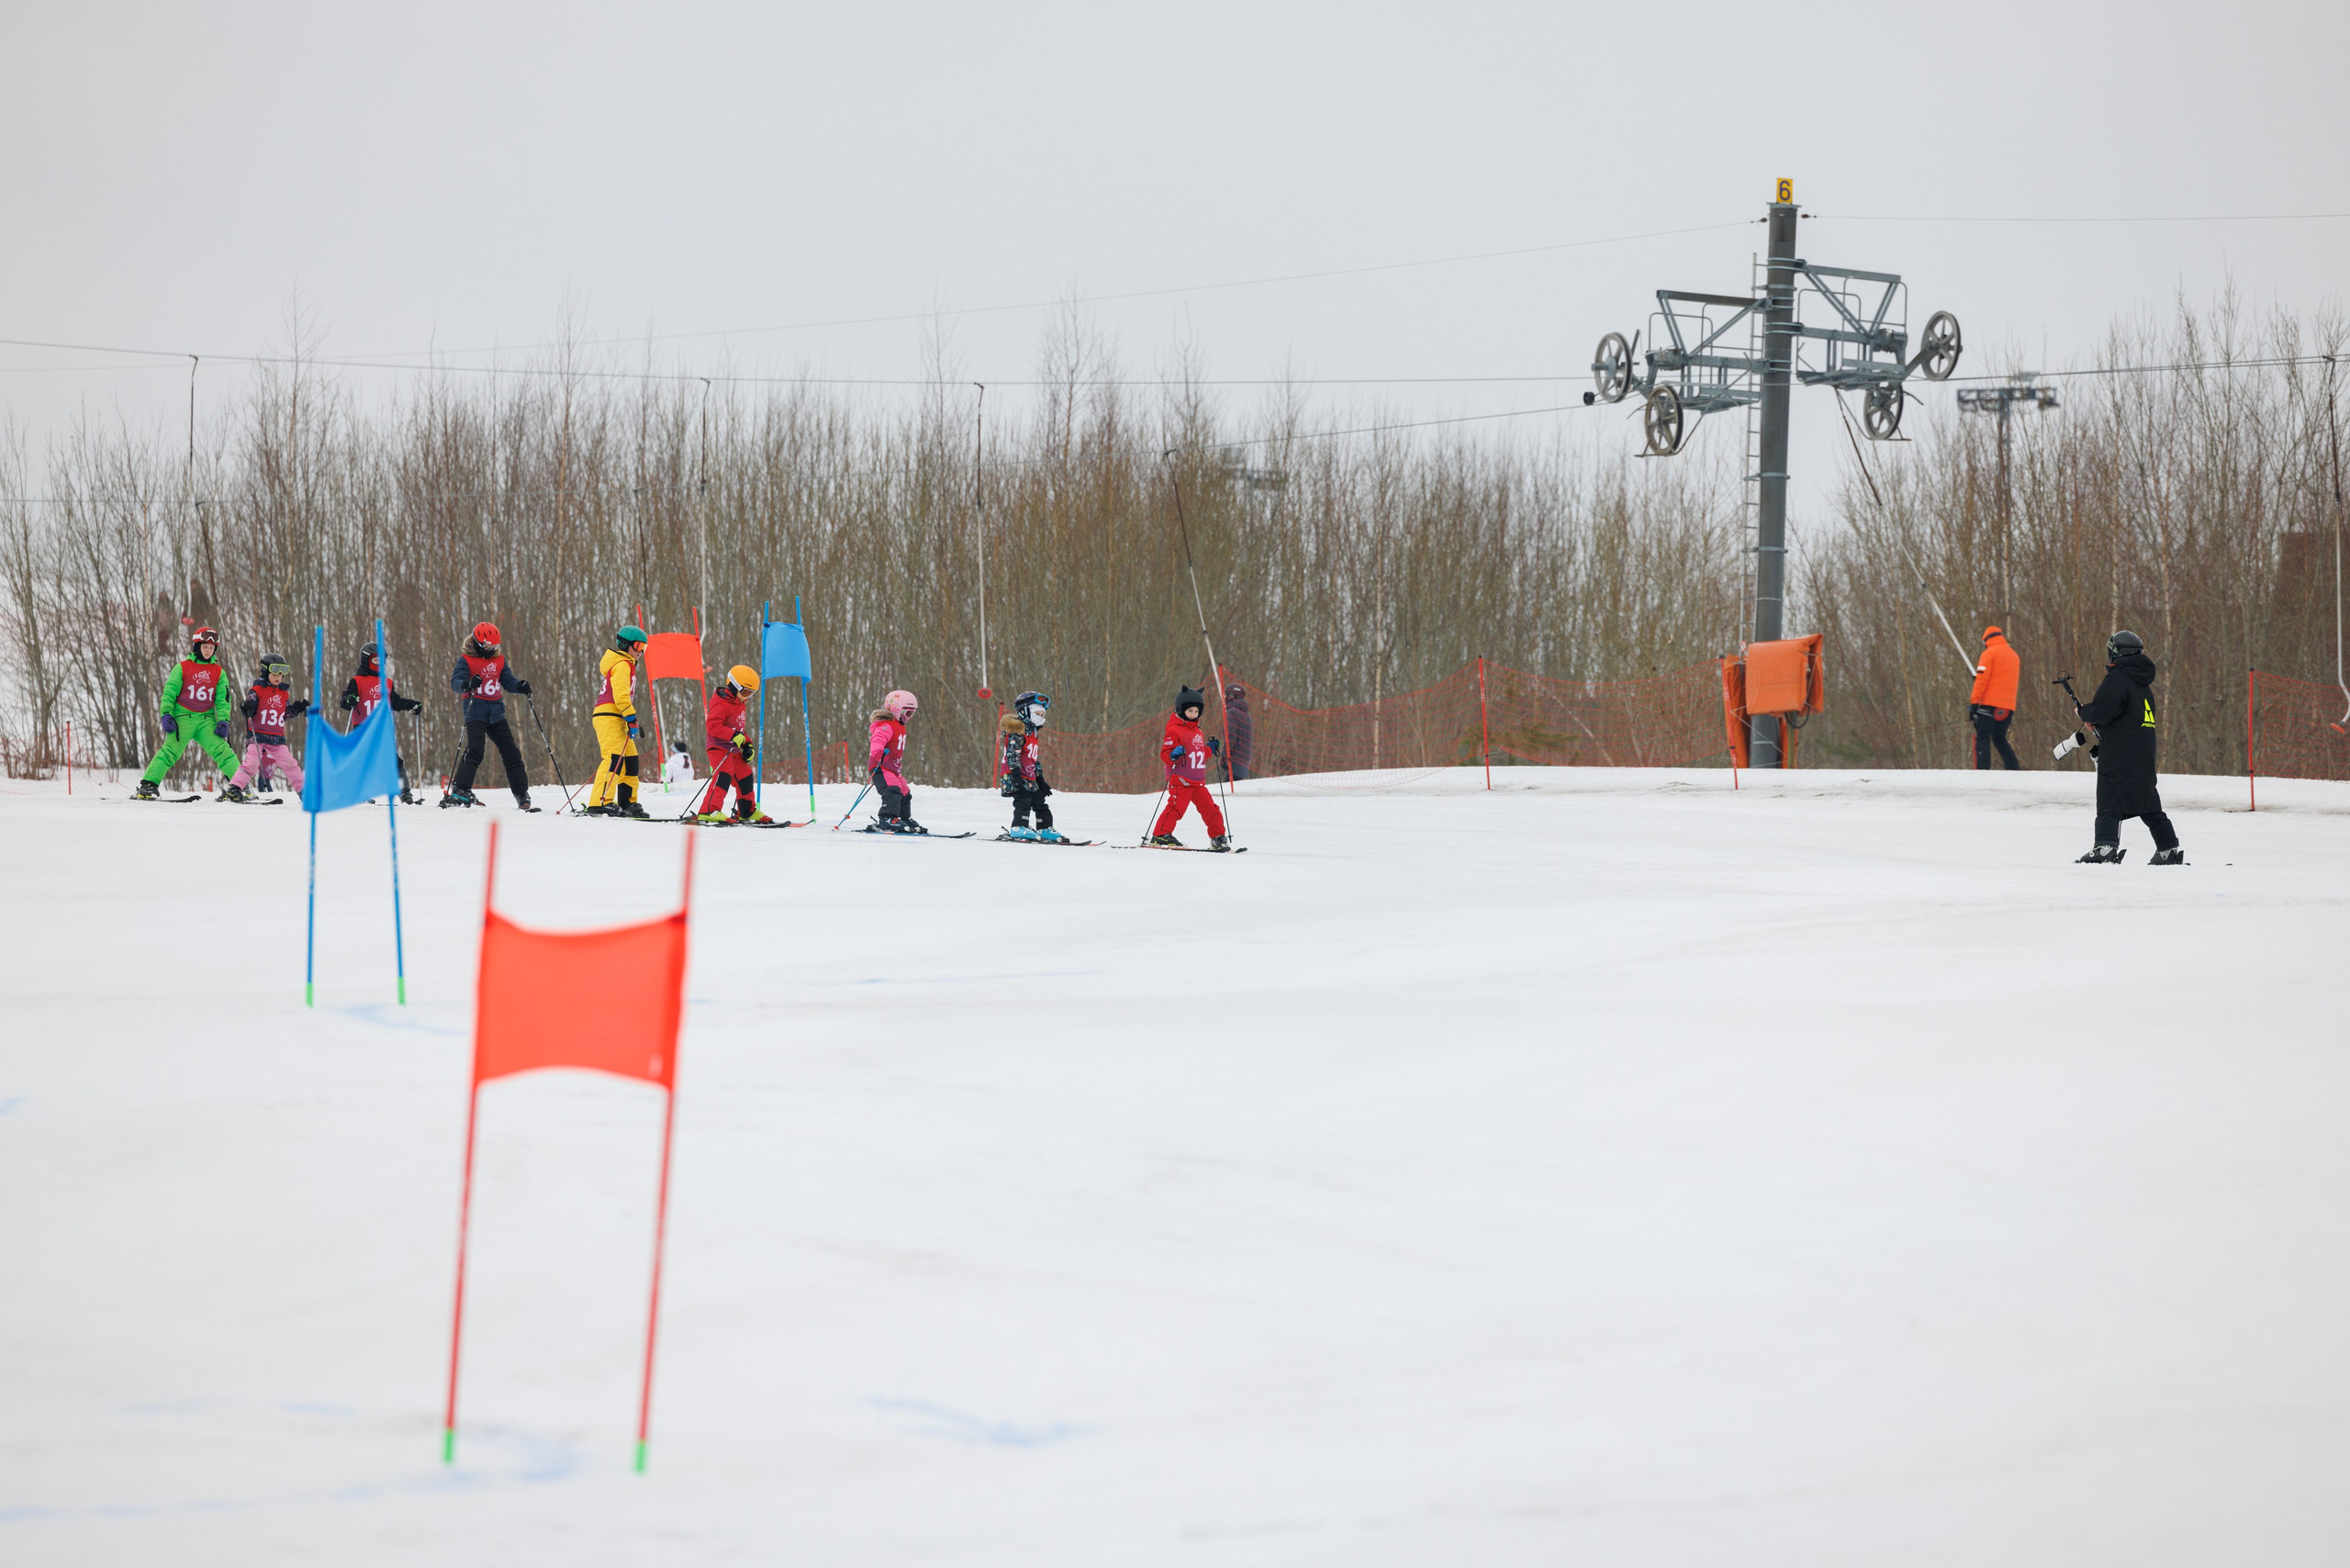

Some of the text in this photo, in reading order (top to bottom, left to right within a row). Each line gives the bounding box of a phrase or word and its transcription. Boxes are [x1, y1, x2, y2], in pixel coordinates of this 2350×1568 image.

[1779, 181, 1791, 201] 6
[187, 685, 214, 701] 161
[260, 709, 285, 728] 136
